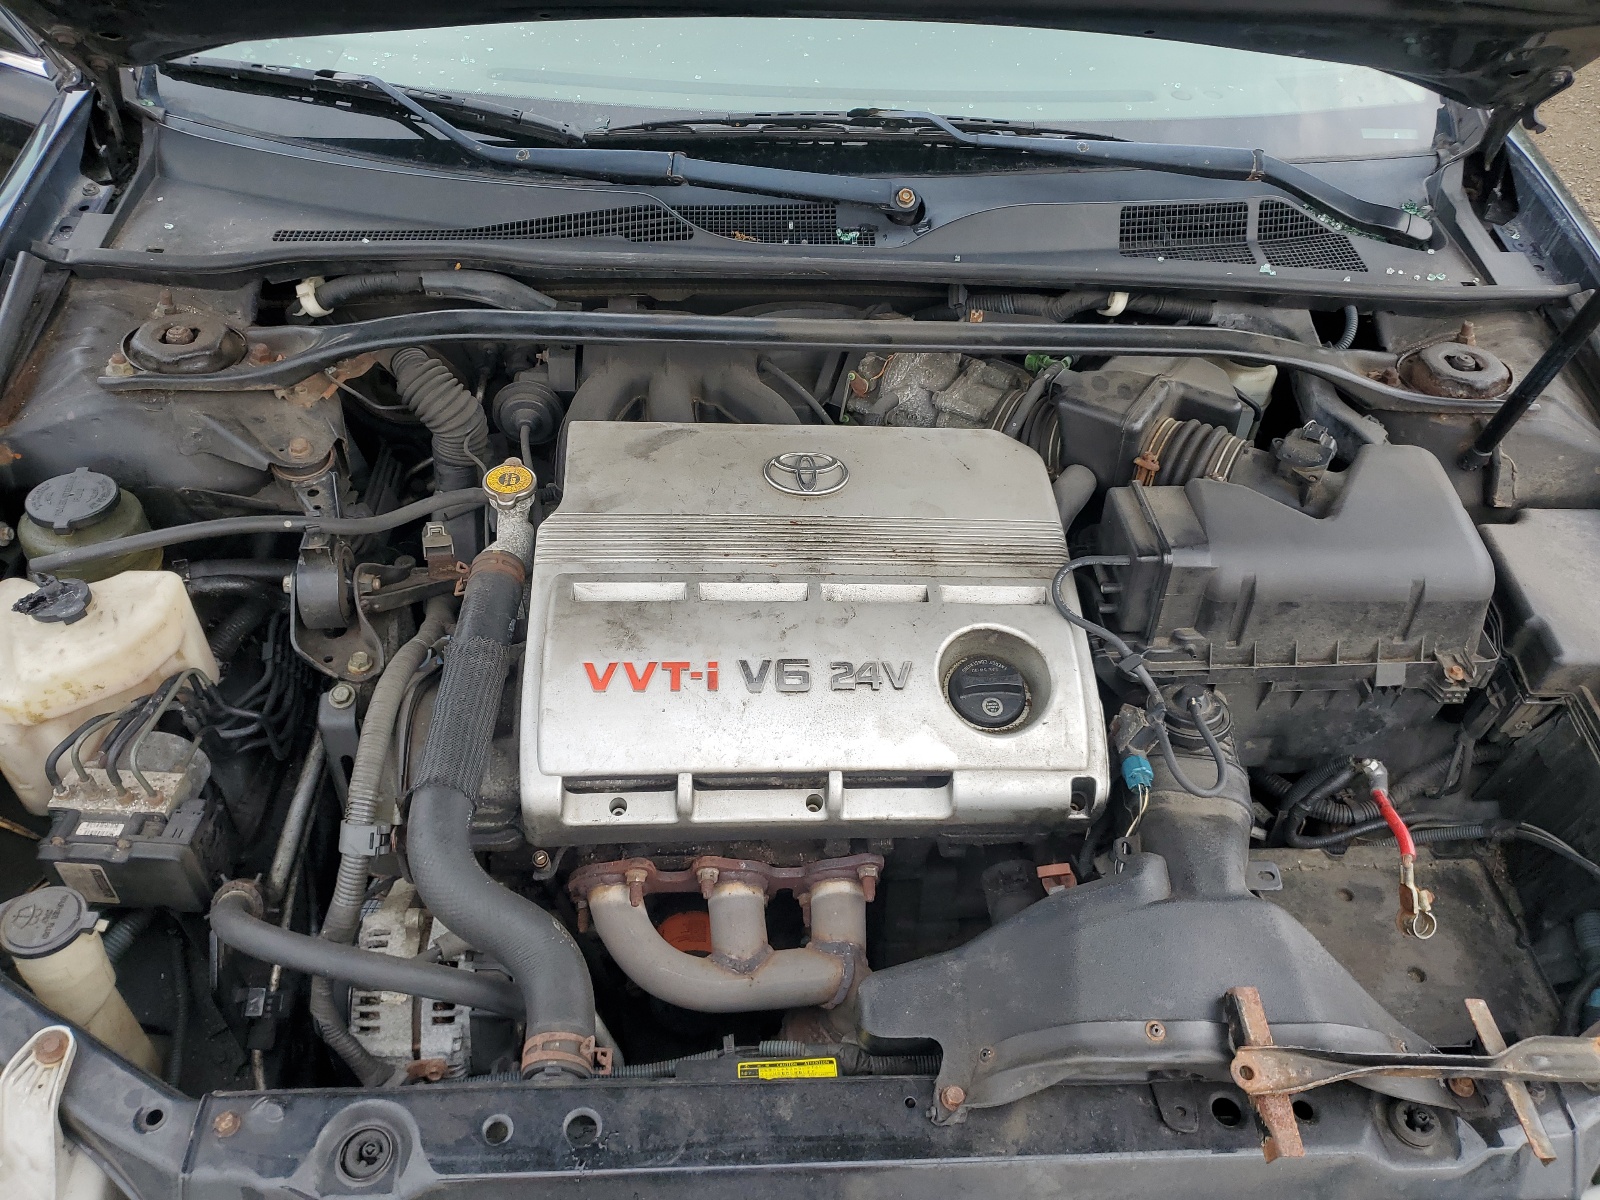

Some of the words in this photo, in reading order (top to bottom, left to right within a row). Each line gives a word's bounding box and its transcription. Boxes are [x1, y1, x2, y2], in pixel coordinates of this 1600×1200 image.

[582, 661, 720, 693] VVT-i
[737, 658, 812, 693] V6
[830, 660, 913, 692] 24V
